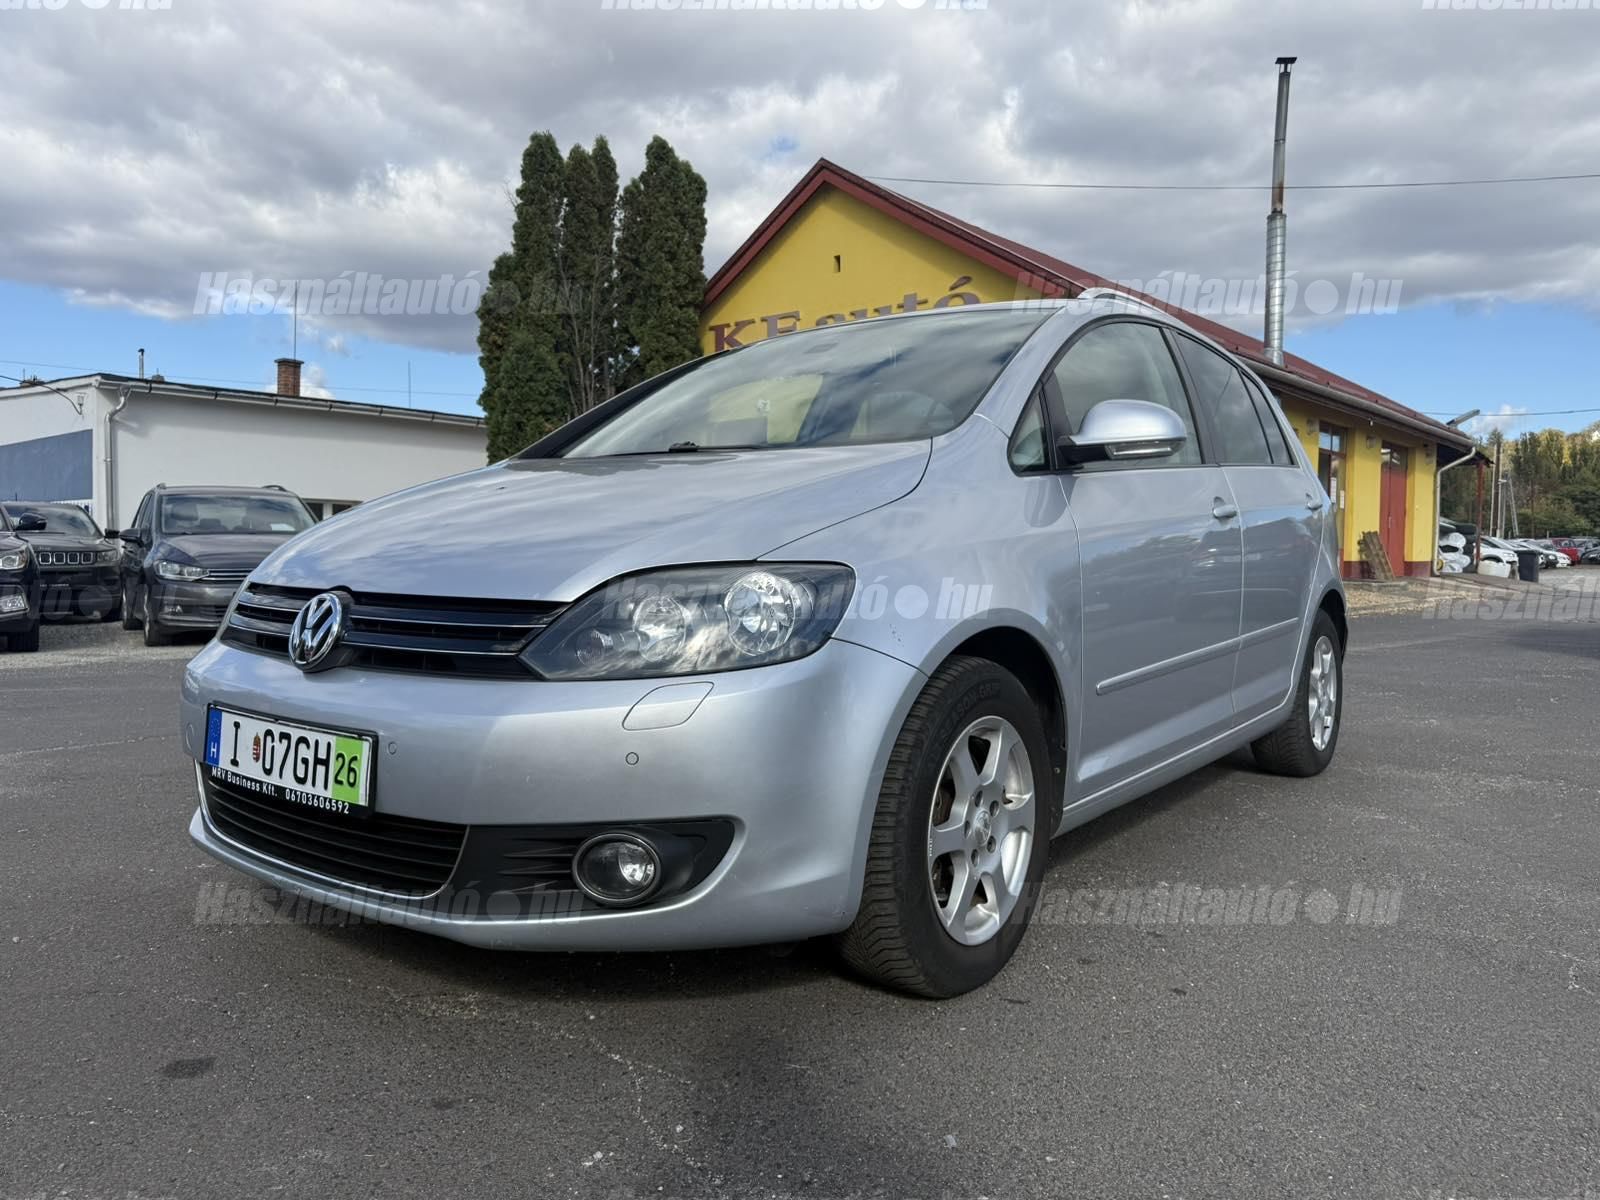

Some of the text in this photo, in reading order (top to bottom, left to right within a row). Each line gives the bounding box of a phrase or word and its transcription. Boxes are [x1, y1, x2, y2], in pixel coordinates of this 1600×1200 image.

[209, 741, 217, 759] H
[334, 752, 358, 788] 26
[227, 772, 260, 792] Business
[262, 782, 278, 797] Kft.
[285, 789, 350, 814] 06703606592
